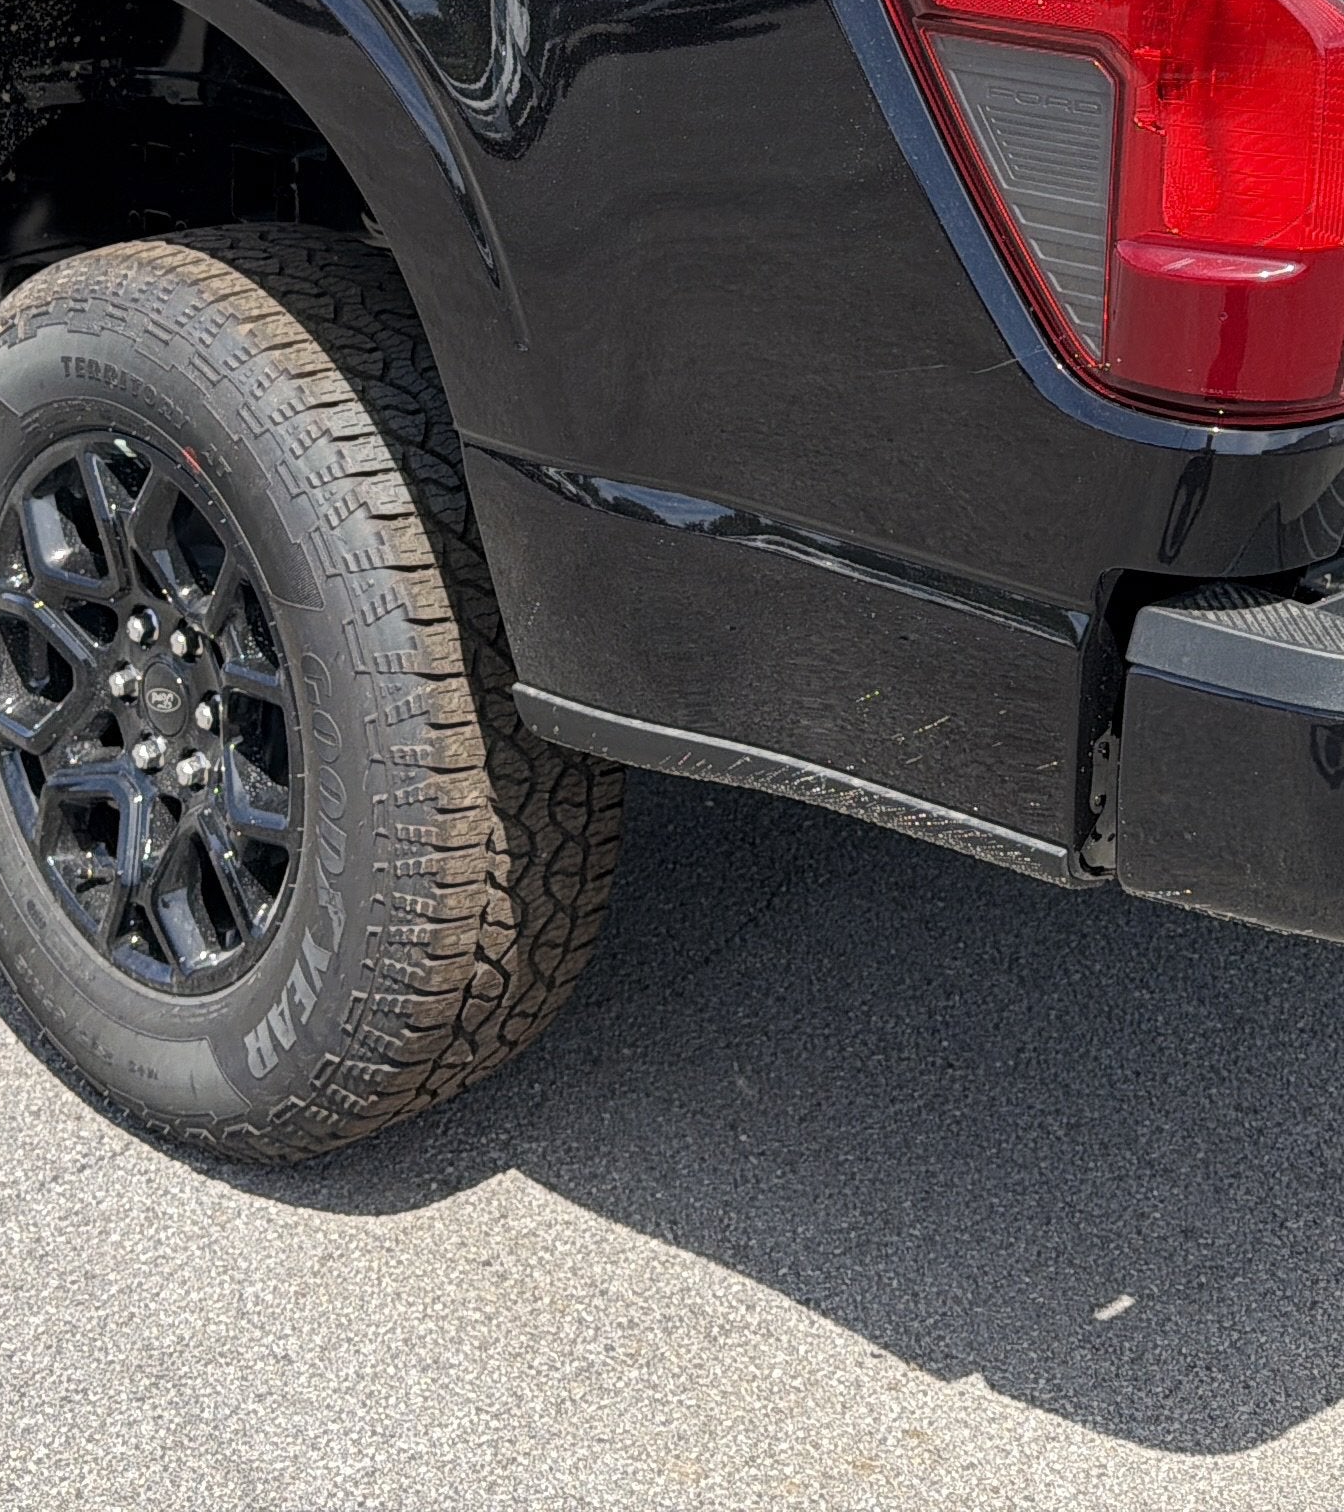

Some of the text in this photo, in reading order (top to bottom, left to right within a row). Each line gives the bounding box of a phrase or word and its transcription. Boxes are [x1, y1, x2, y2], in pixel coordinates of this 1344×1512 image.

[986, 86, 1104, 117] FORD
[60, 355, 193, 430] TERRITORY
[243, 650, 347, 1080] GOODYEAR
